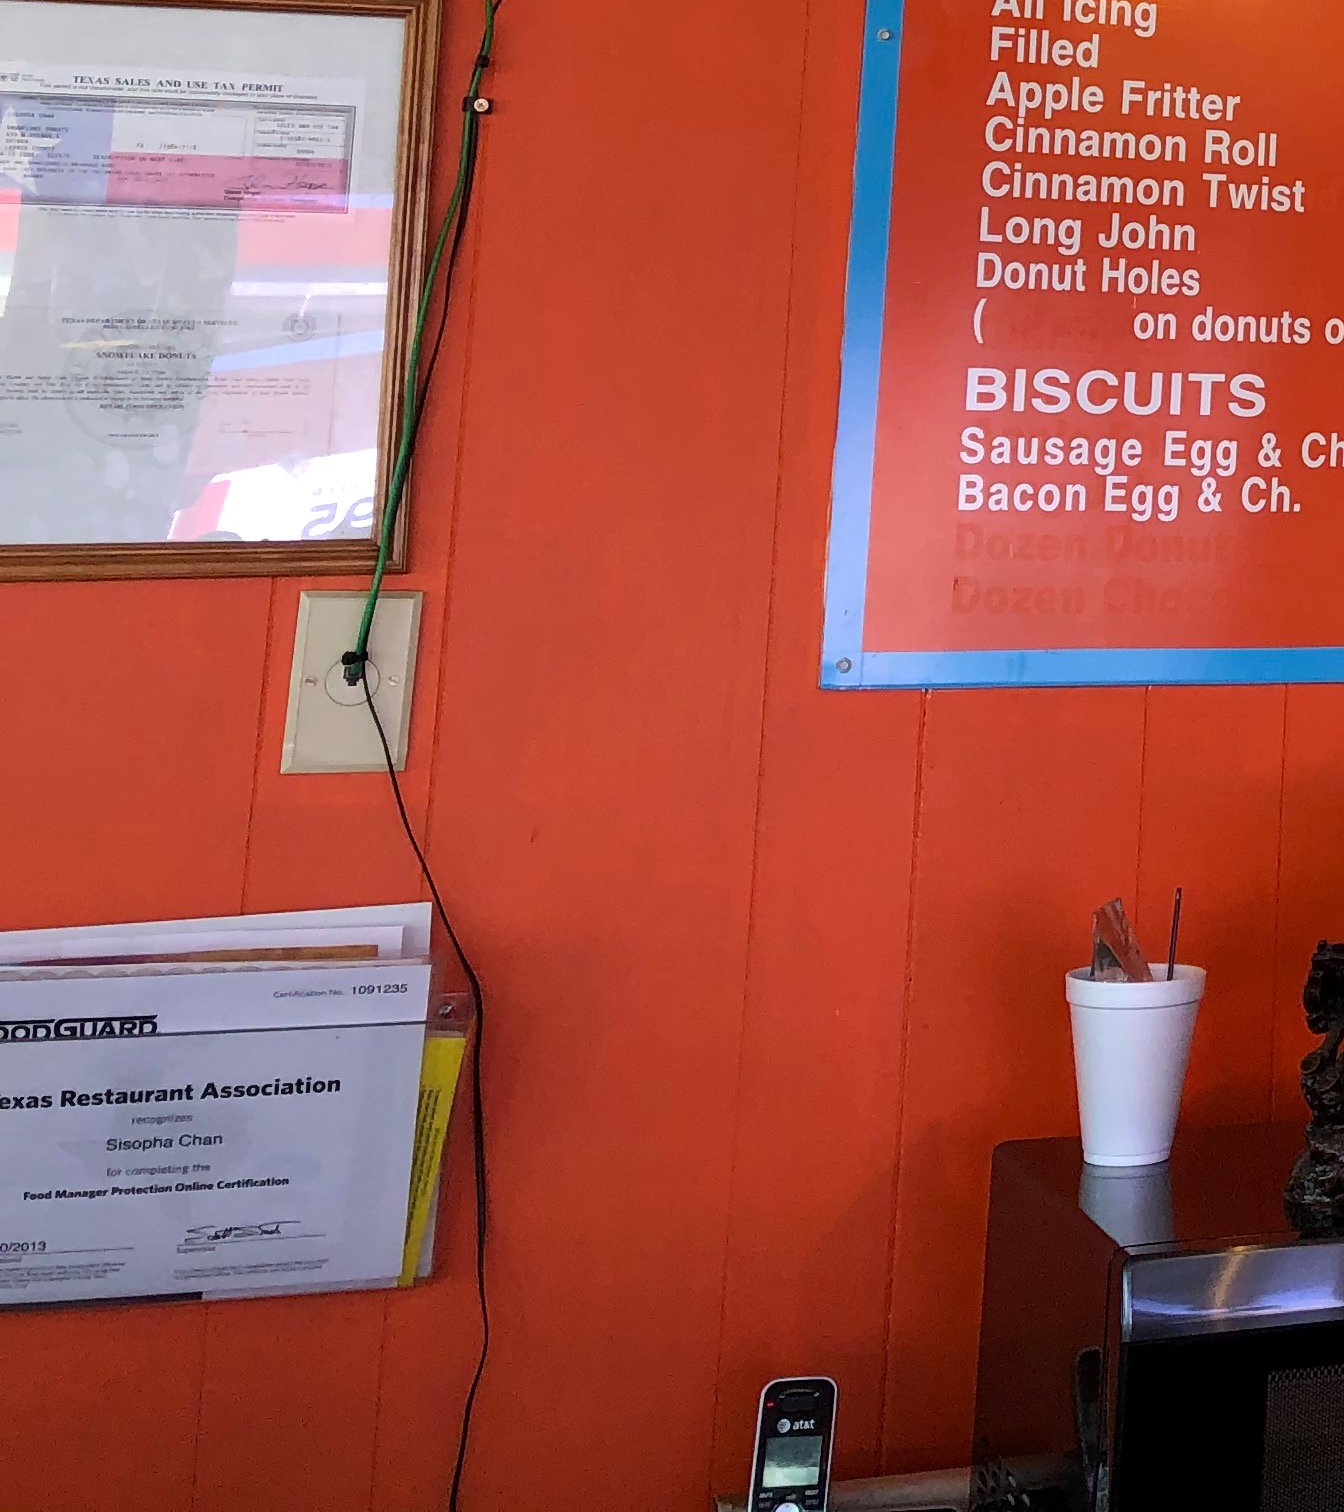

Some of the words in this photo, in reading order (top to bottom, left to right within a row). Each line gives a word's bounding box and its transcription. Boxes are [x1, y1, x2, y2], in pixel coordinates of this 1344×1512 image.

[991, 27, 1099, 67] Filled
[73, 75, 110, 86] TEXAS
[115, 76, 150, 86] SALES
[158, 78, 181, 87] AND
[187, 80, 208, 89] USE
[214, 82, 235, 90] TAX
[241, 83, 283, 93] PERMIT
[986, 72, 1103, 119] Apple
[1122, 81, 1240, 121] Fritter
[986, 116, 1186, 161] Cinnamon
[1205, 130, 1276, 166] Roll
[983, 161, 1183, 206] Cinnamon
[1203, 174, 1304, 212] Twist
[980, 207, 1081, 255] Long
[1099, 213, 1195, 250] John
[977, 252, 1086, 291] Donut
[1102, 258, 1199, 296] Holes
[1134, 313, 1176, 339] on
[1192, 307, 1310, 344] donuts
[966, 368, 1265, 417] BISCUITS
[960, 426, 1142, 475] Sausage
[1164, 431, 1237, 476] Egg
[1258, 433, 1281, 467] &
[958, 473, 1086, 511] Bacon
[1104, 476, 1179, 522] Egg
[1198, 477, 1222, 512] &
[1242, 477, 1300, 512] Ch.
[352, 984, 408, 995] 1091235
[0, 1093, 52, 1109] exas
[60, 1084, 193, 1108] Restaurant
[200, 1076, 341, 1100] Association
[106, 1137, 172, 1153] Sisopha
[179, 1133, 223, 1147] Chan
[24, 1191, 52, 1201] Food
[55, 1187, 108, 1200] Manager
[111, 1185, 172, 1196] Protection
[175, 1181, 214, 1193] Online
[217, 1176, 289, 1190] Certification
